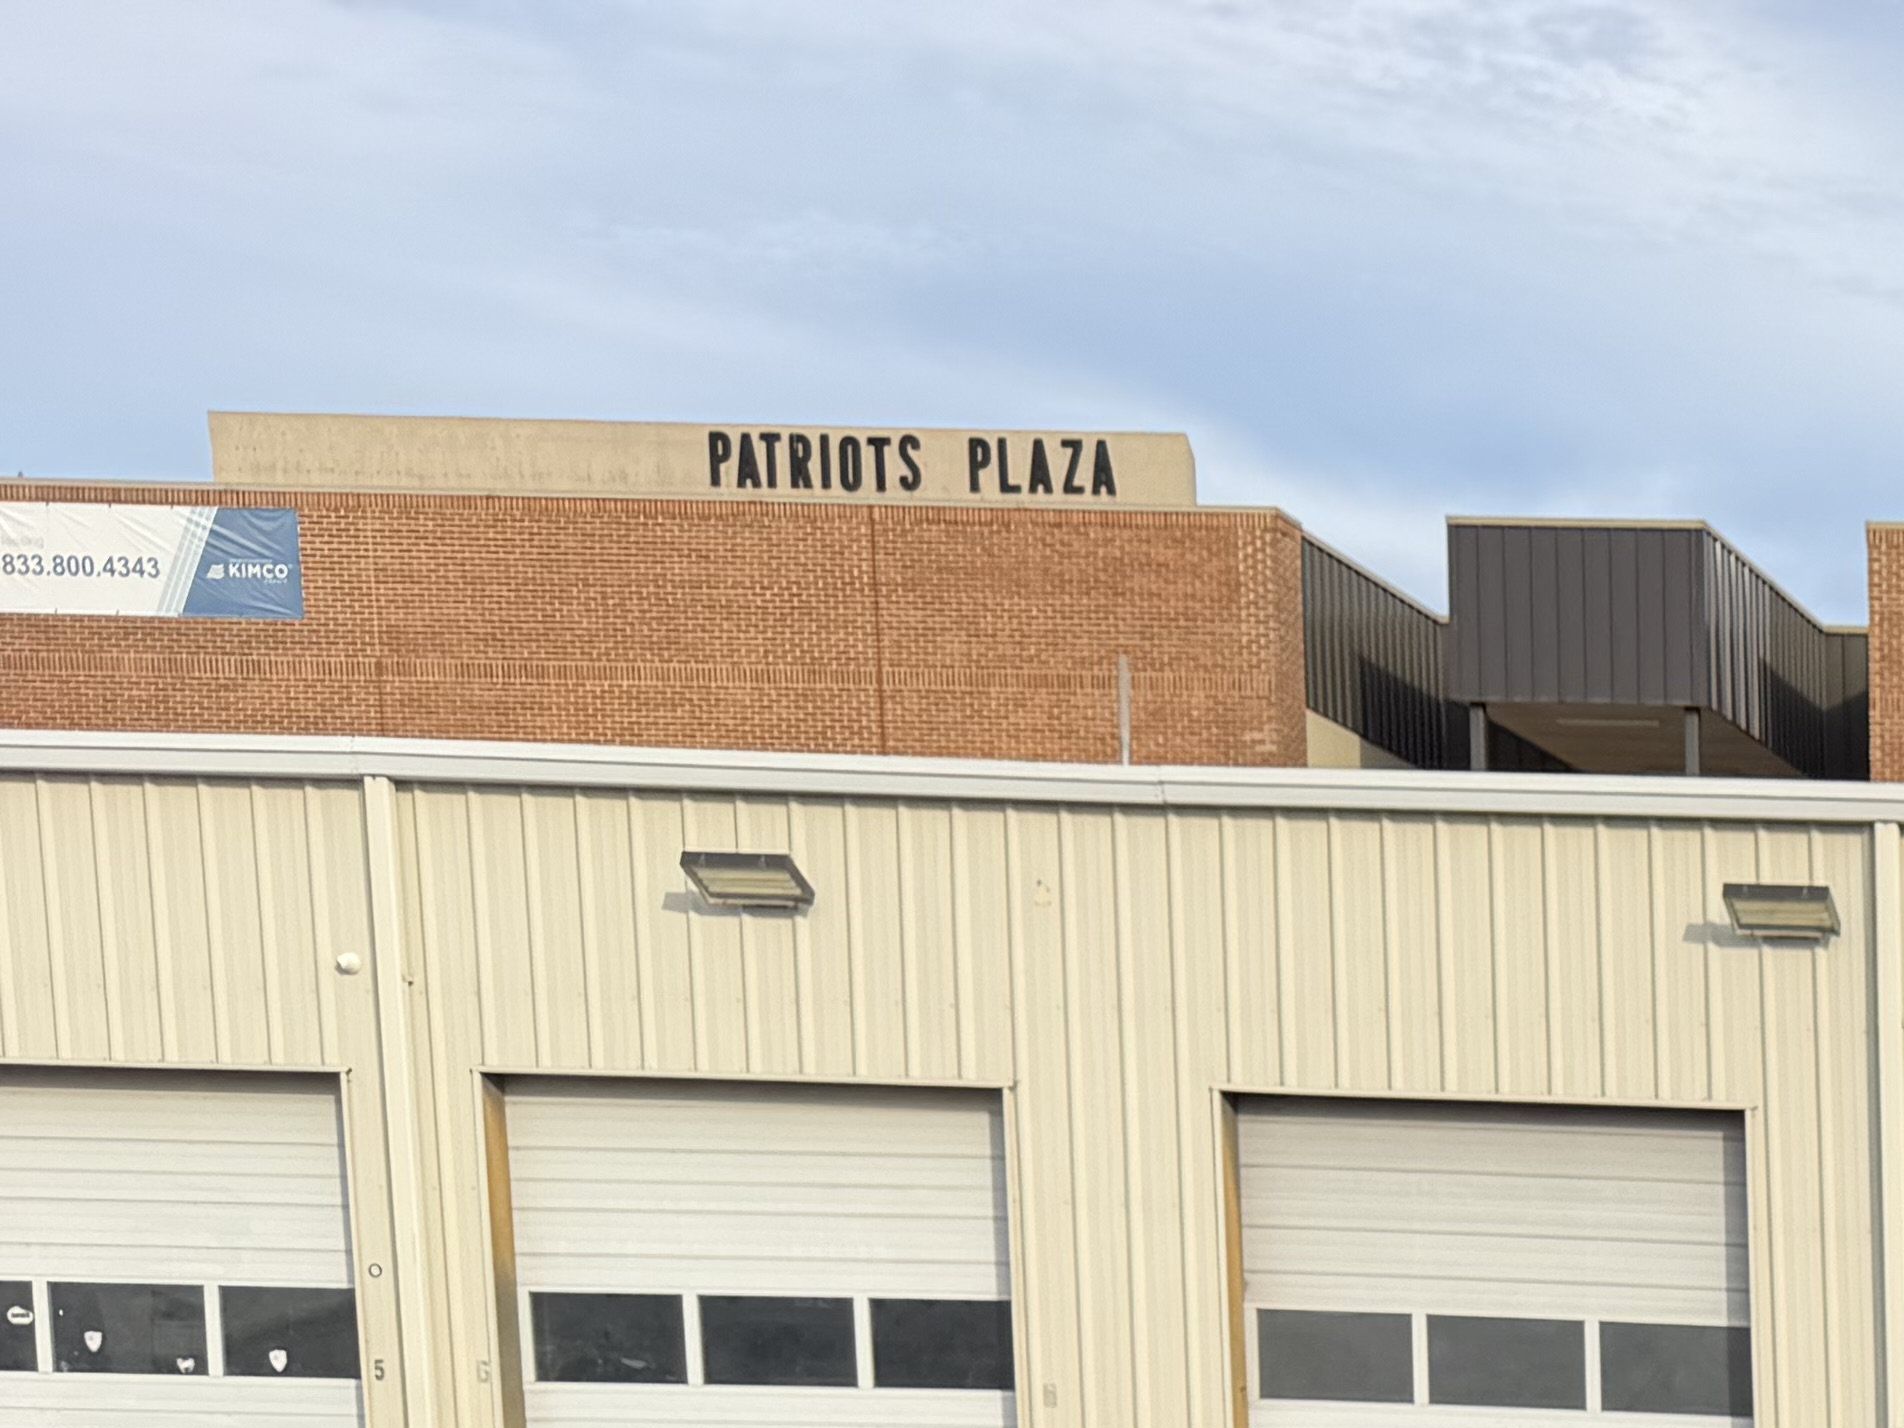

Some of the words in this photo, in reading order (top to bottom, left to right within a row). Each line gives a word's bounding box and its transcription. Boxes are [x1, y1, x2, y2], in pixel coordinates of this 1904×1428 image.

[707, 431, 922, 492] PATRIOTS
[966, 436, 1118, 497] PLAZA
[1, 552, 161, 579] 833.800.4343
[228, 562, 289, 579] KIMCO
[374, 1358, 385, 1381] 5
